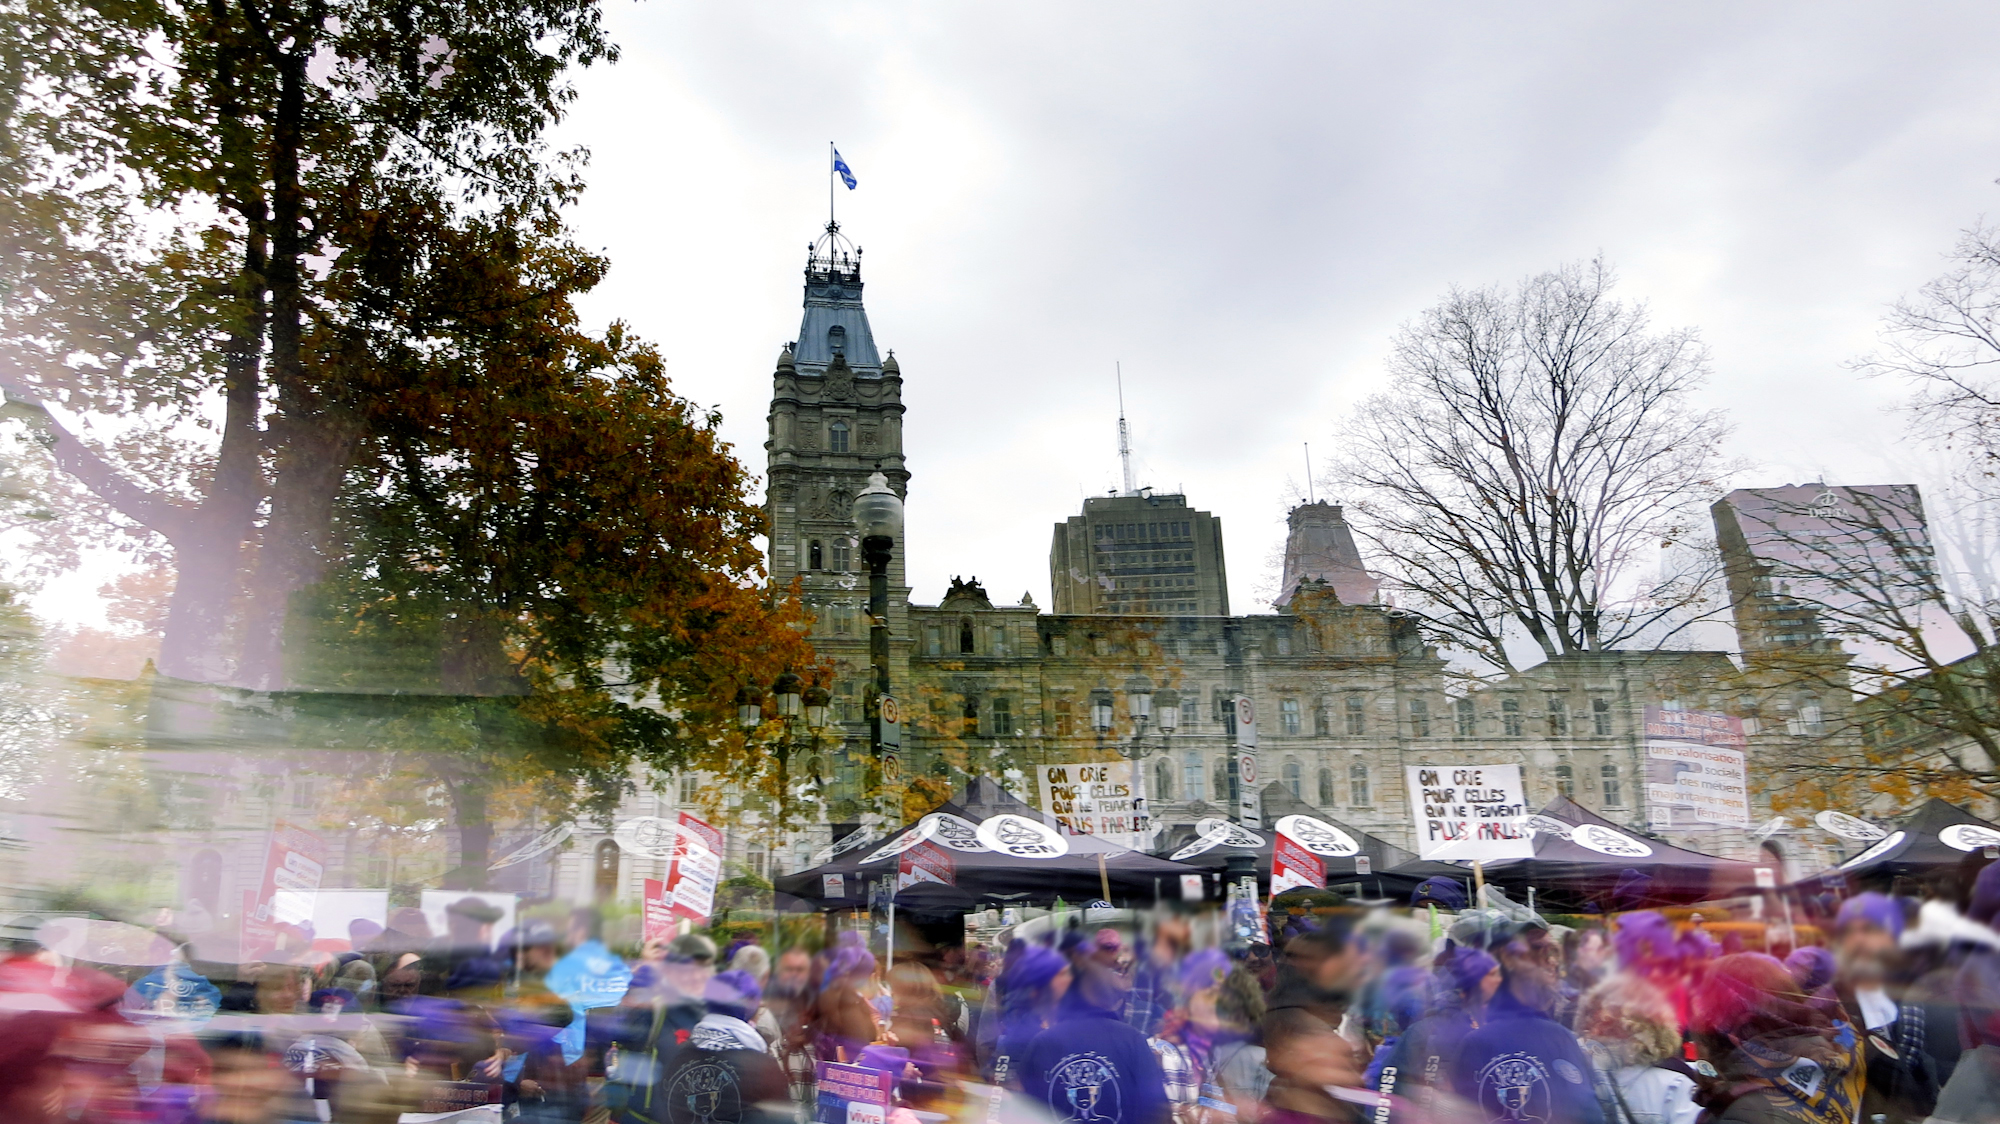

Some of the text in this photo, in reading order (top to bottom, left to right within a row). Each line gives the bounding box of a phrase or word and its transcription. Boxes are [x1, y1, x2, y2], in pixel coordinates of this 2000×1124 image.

[1659, 710, 1709, 727] ENCORE
[1646, 722, 1702, 739] MARCHE
[1651, 746, 1741, 765] une valorisation
[1047, 767, 1069, 784] ON
[1419, 769, 1440, 787] ON
[1704, 766, 1742, 780] sociale
[1050, 784, 1130, 801] POUR CELLES
[1679, 777, 1743, 795] des métiers
[1422, 788, 1507, 804] POUR CELLES
[1651, 788, 1744, 809] majoritairement
[1079, 802, 1093, 813] NE
[1099, 798, 1144, 813] PEUVENT
[1453, 805, 1468, 818] NE
[1473, 803, 1524, 818] PEUVENT
[1697, 807, 1746, 823] féminins
[1056, 816, 1152, 836] PLUS PARLER
[1428, 819, 1532, 841] PLUS PARLER
[1008, 844, 1060, 855] CSN
[1224, 838, 1260, 846] CSN
[1307, 842, 1353, 852] CSN
[1603, 846, 1645, 854] CSN
[825, 1067, 863, 1085] ENCORE
[857, 1086, 887, 1103] POUR
[849, 1108, 881, 1124] vivre
